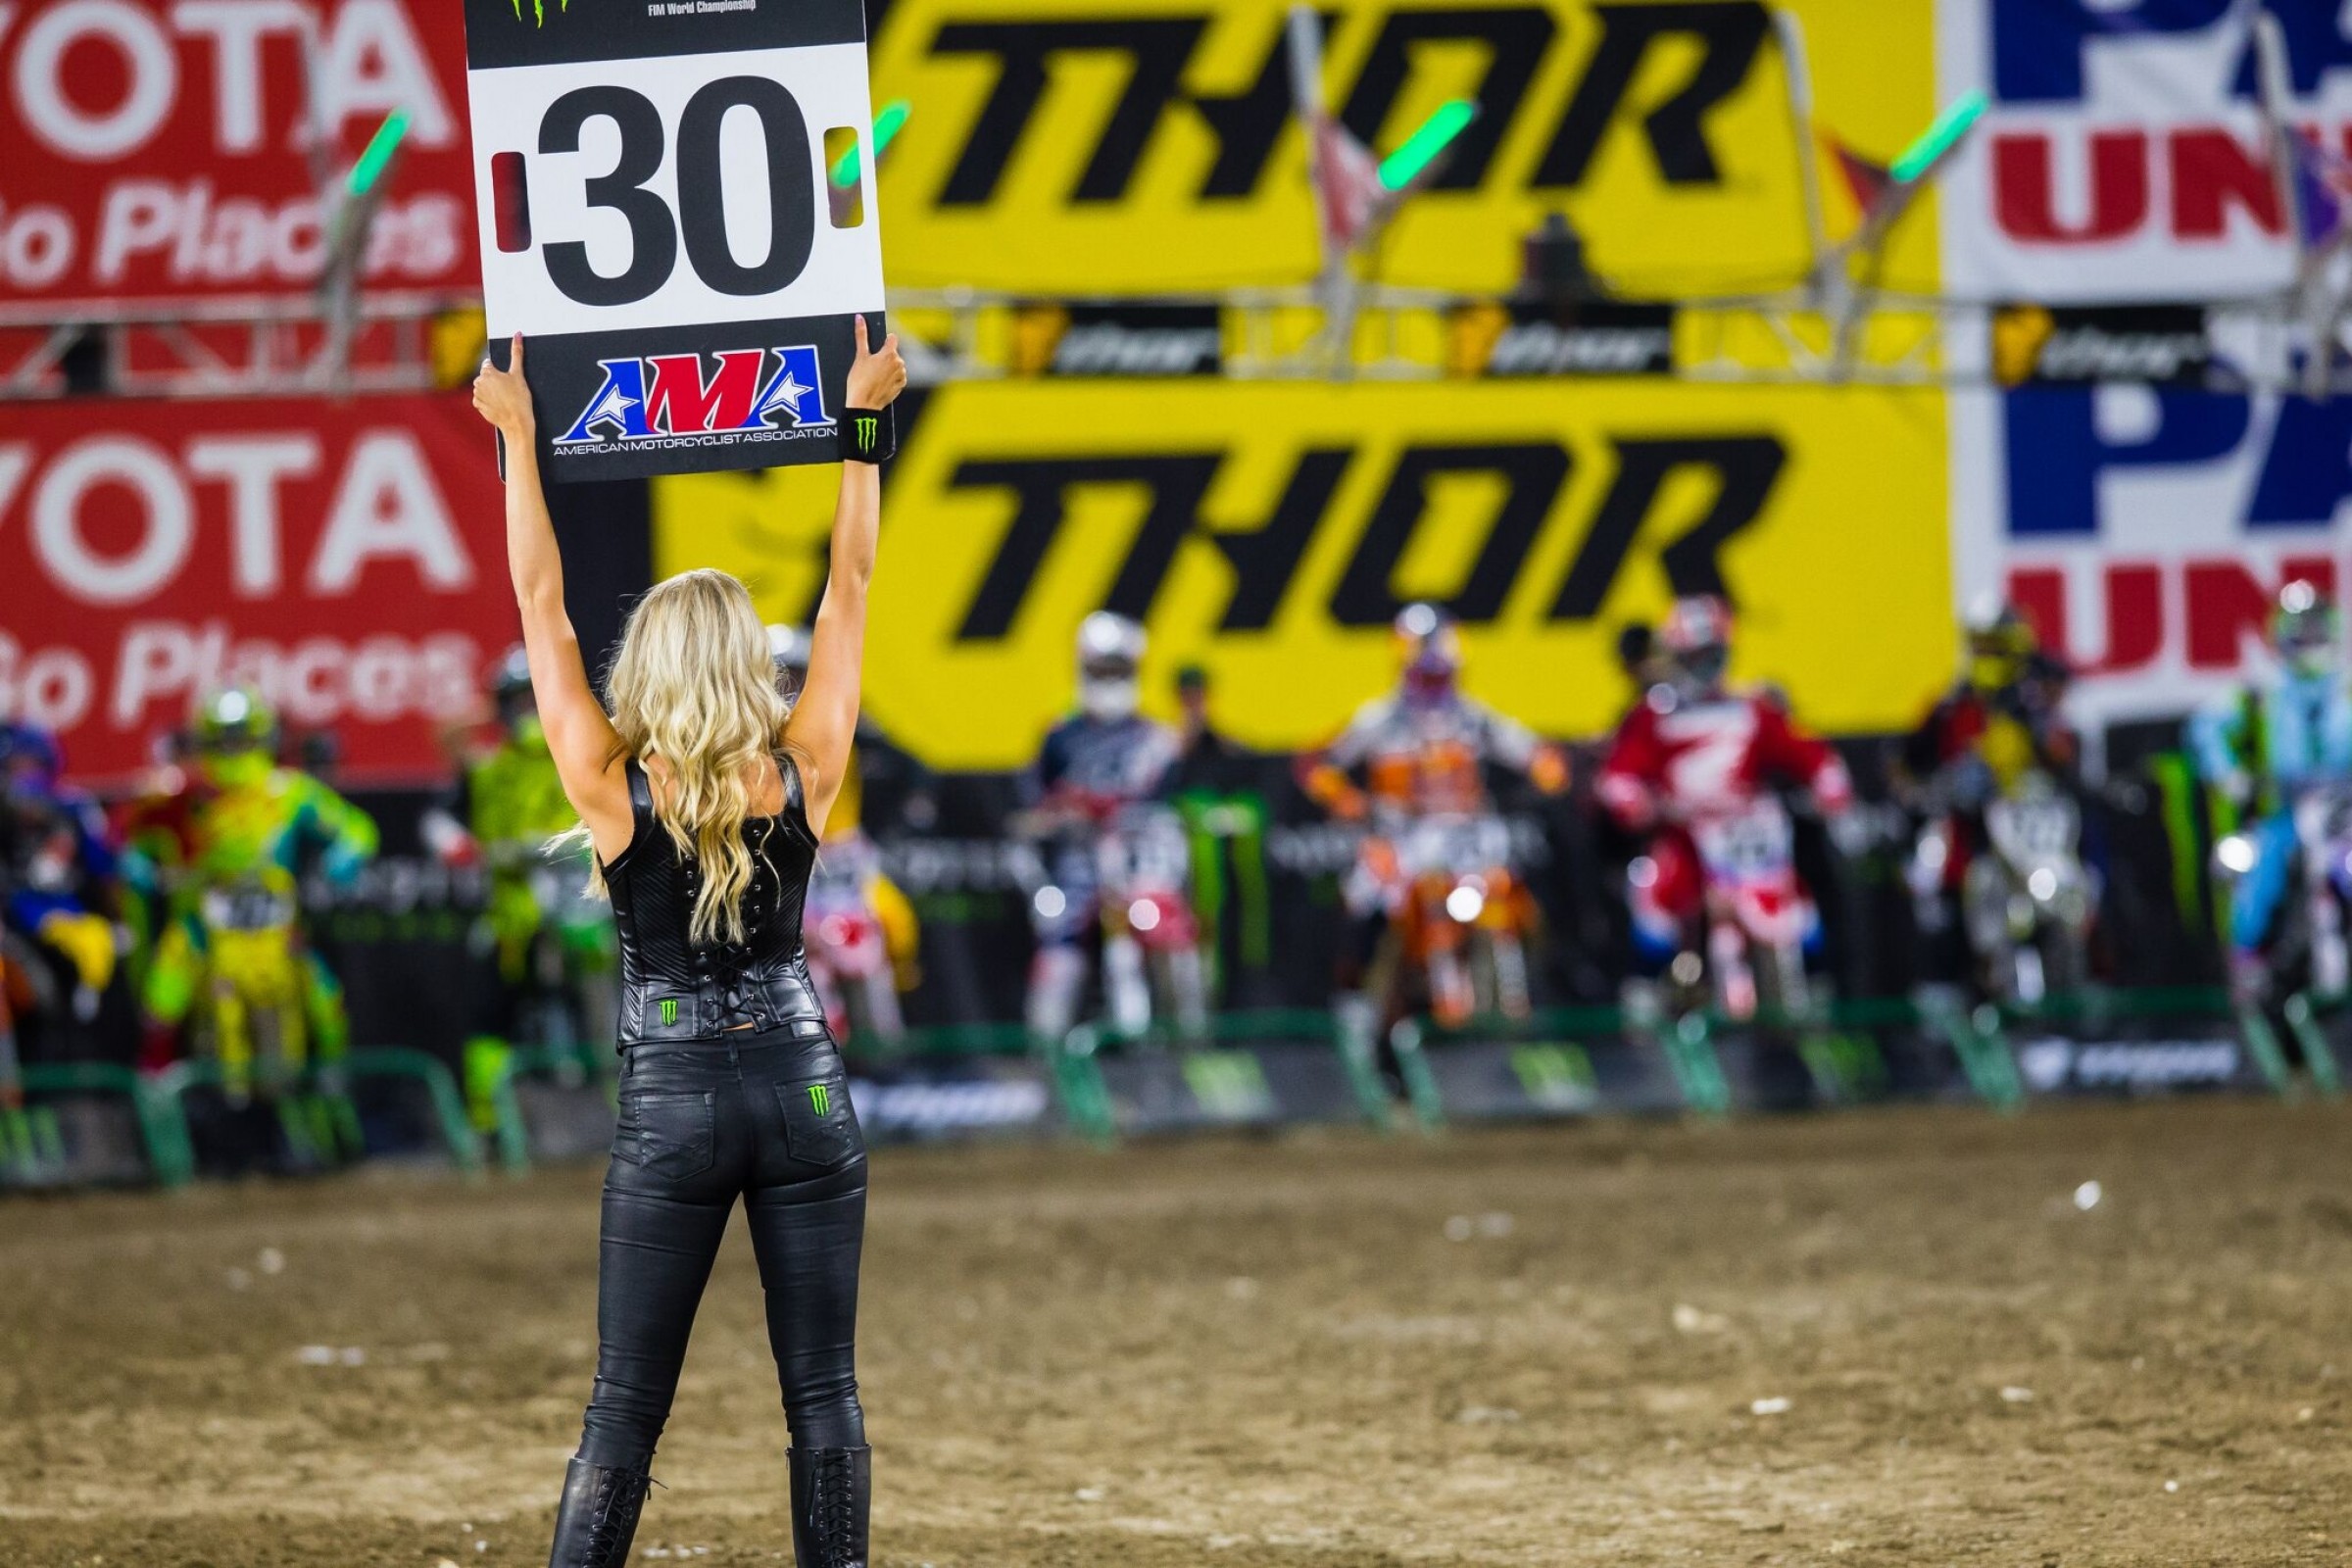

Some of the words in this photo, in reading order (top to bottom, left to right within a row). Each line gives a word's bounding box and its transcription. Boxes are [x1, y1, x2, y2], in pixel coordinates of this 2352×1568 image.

[648, 4, 665, 17] FIM
[666, 2, 695, 15] World
[696, 0, 757, 13] Championship
[0, 0, 457, 159] OTA
[927, 2, 1778, 208] THOR
[0, 178, 76, 288] o
[538, 74, 815, 308] 30
[1991, 125, 2352, 245] UN
[553, 344, 837, 445] AMA
[554, 442, 629, 456] AMERICAN
[630, 431, 742, 451] MOTORCYCLIST
[743, 427, 838, 443] ASSOCIATION
[0, 431, 476, 606] OTA
[943, 433, 1789, 647] THOR
[0, 635, 93, 733] o
[110, 621, 480, 729] Places
[1660, 702, 1756, 806] 7
